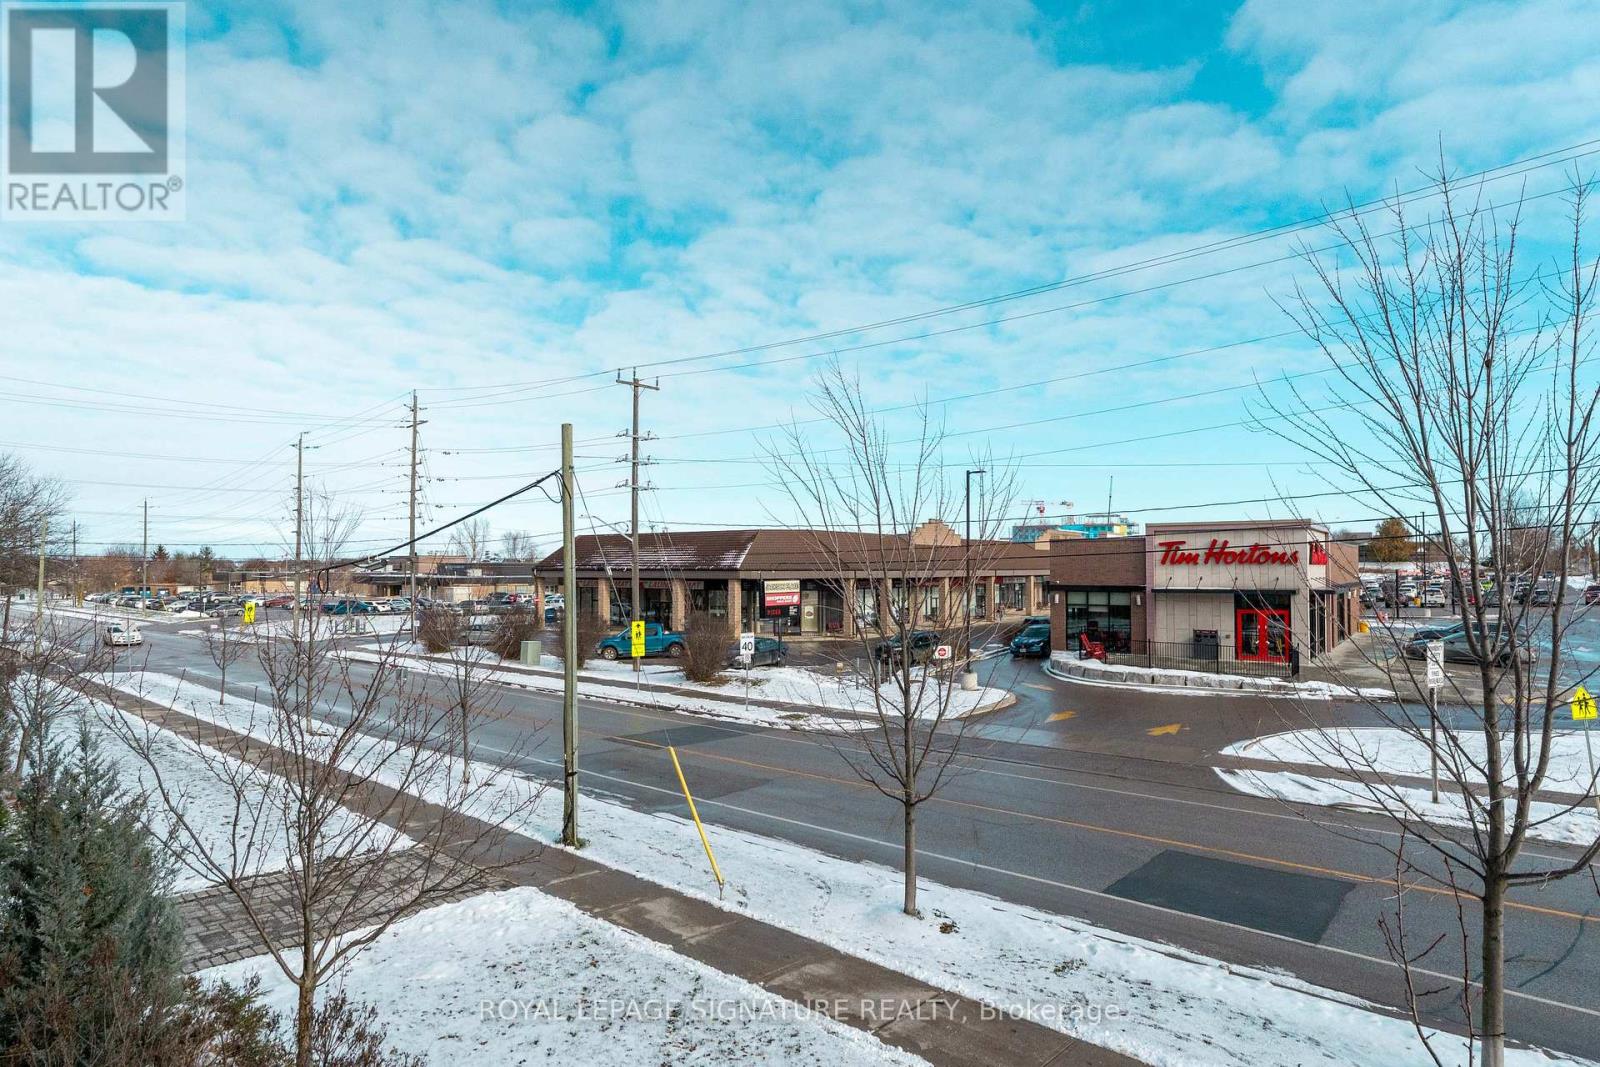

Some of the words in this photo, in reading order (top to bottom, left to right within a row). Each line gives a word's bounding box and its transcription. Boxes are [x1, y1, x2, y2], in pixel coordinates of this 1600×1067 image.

[1158, 540, 1200, 566] Tim
[1203, 538, 1299, 566] Hortons
[741, 641, 753, 651] 40
